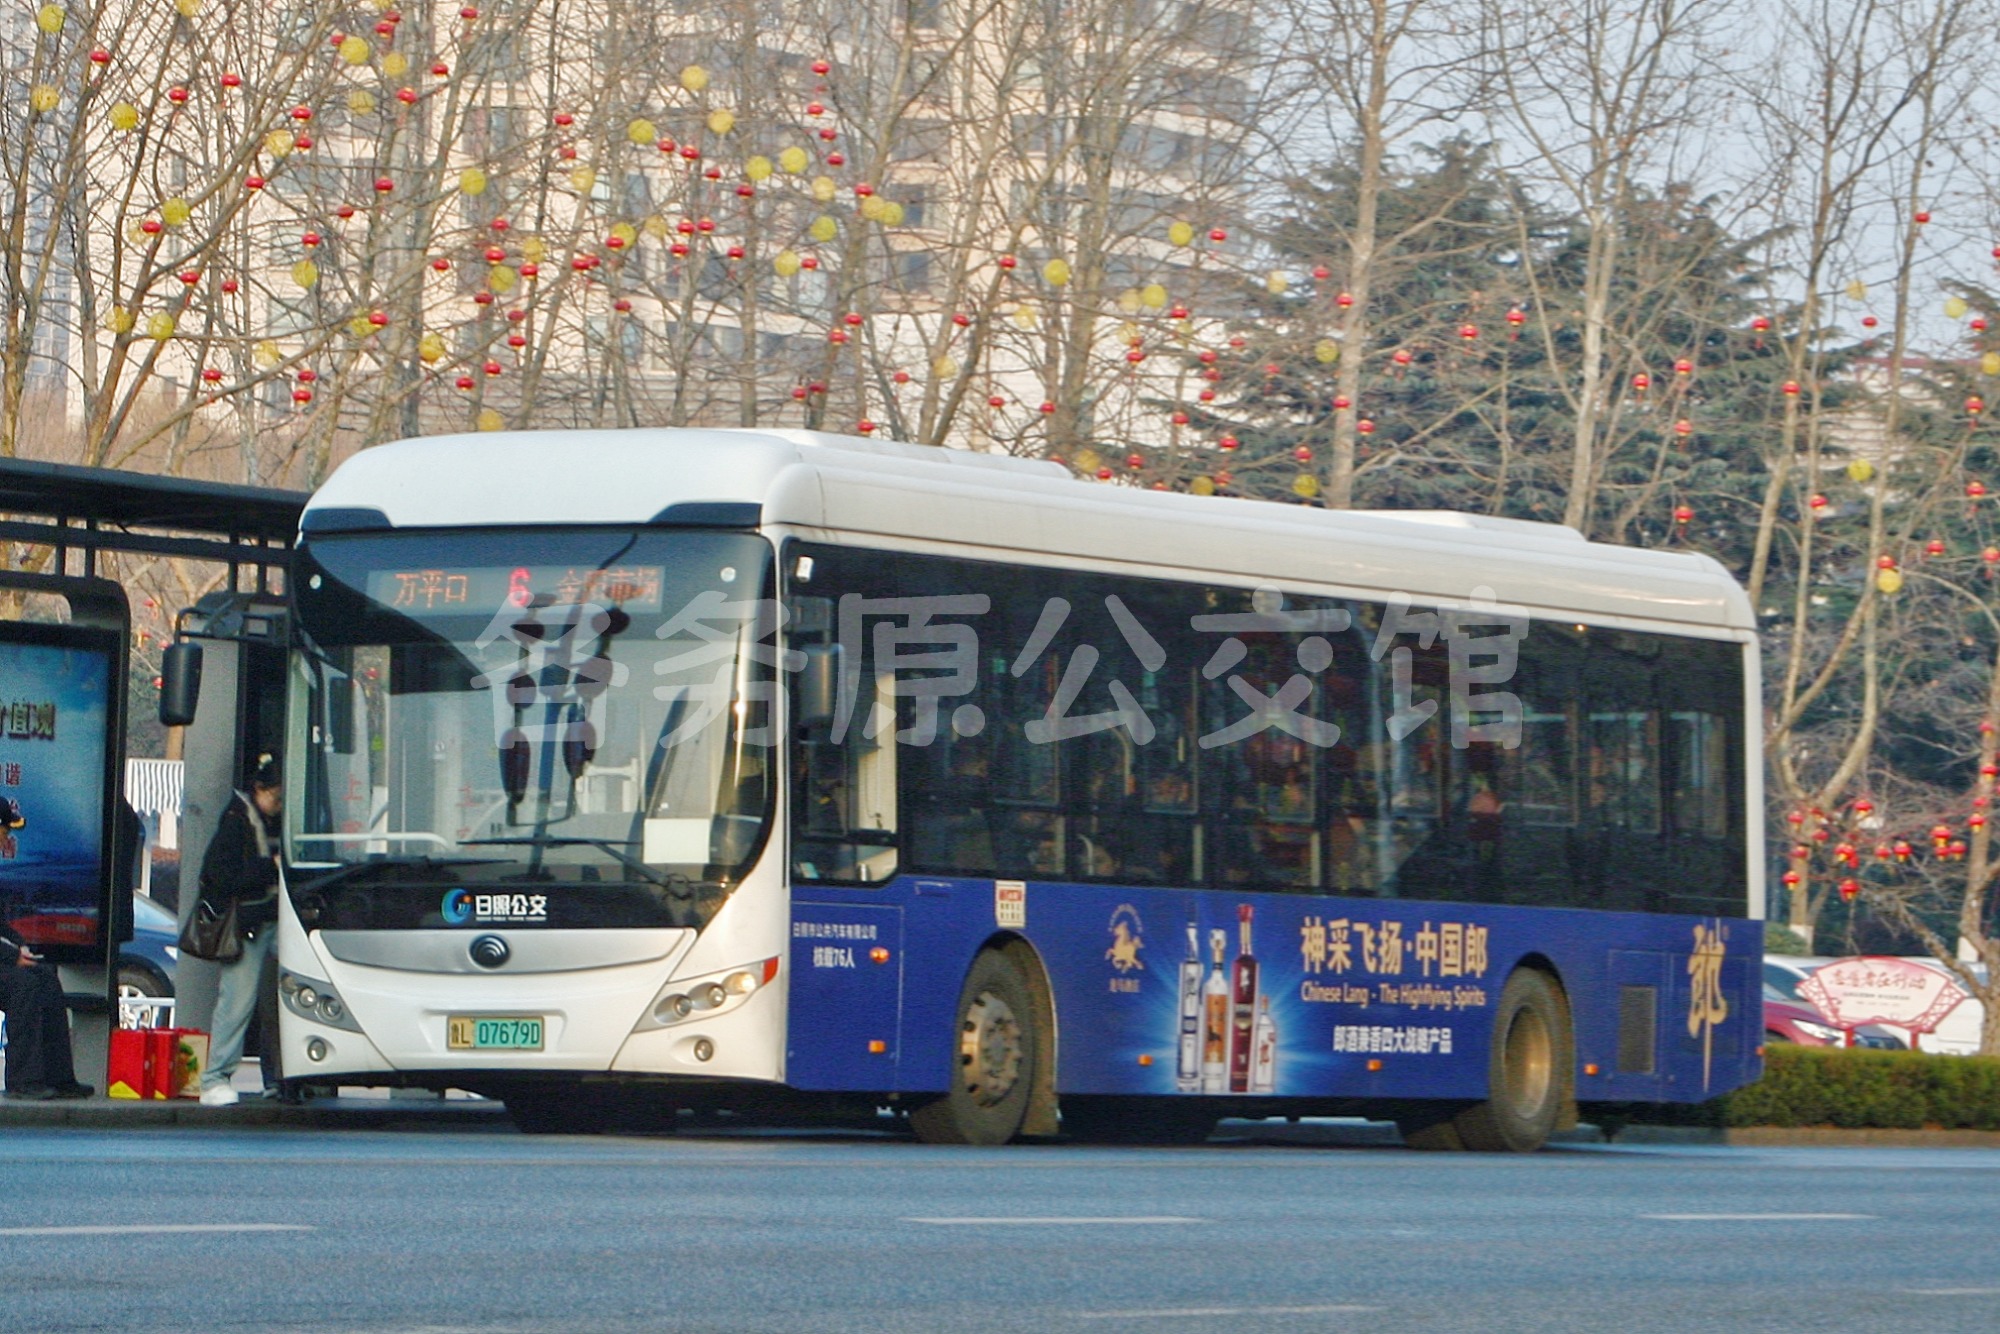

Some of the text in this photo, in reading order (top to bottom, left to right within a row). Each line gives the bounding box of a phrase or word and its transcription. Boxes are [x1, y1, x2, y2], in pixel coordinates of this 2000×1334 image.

[393, 569, 468, 609] 万平口
[508, 566, 532, 609] 6
[0, 701, 56, 740] 值观
[475, 894, 548, 916] 日照公交
[1301, 980, 1341, 1003] Chinese
[1343, 982, 1370, 1010] Lang
[1379, 983, 1399, 1004] The
[1454, 985, 1487, 1012] Spirits
